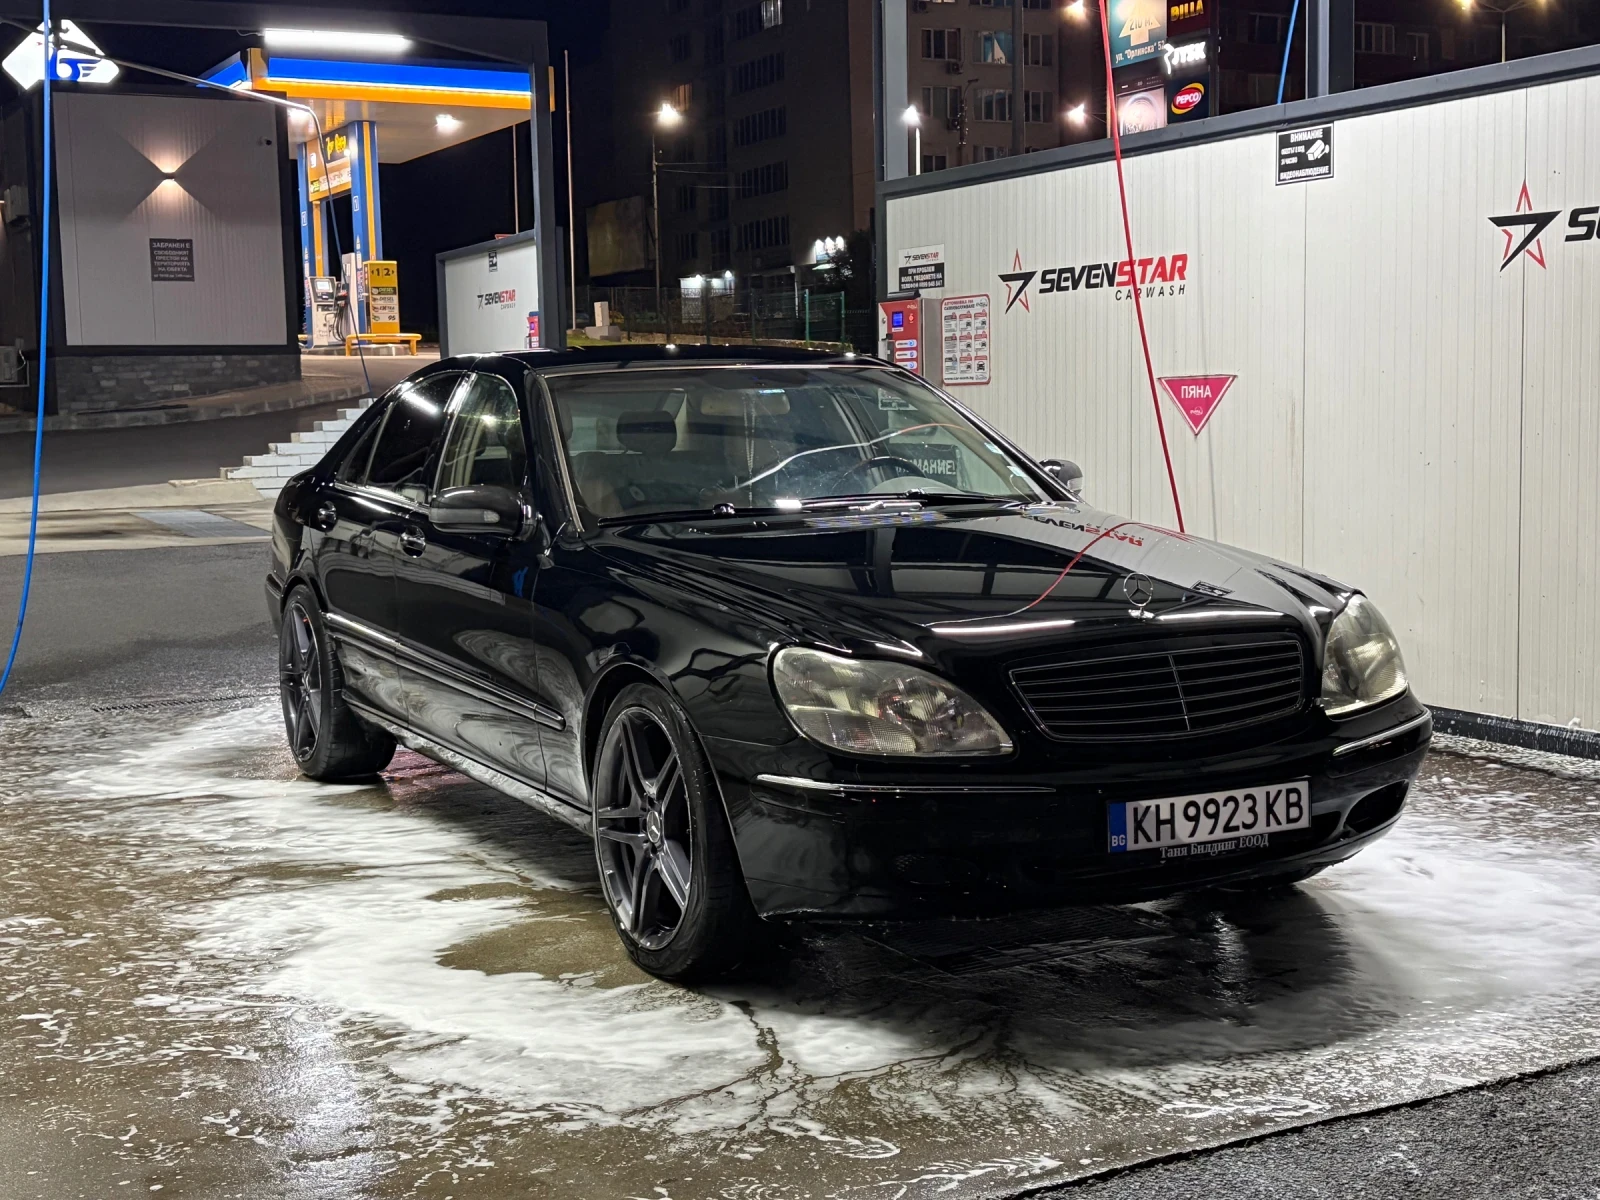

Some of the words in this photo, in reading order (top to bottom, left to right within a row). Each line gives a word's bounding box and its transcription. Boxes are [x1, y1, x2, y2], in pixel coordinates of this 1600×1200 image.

[1170, 0, 1204, 21] BILLA
[1176, 91, 1199, 105] PEPCO
[1290, 128, 1323, 143] ВНИМАНИЕ
[1564, 205, 1600, 242] S
[912, 251, 939, 261] SEVENSTAR
[375, 268, 380, 276] 1
[384, 268, 391, 276] 2
[1039, 254, 1188, 294] SEVENSTAR
[1181, 385, 1213, 399] ПЯНА
[1111, 834, 1126, 847] BG
[1160, 846, 1188, 859] Таня
[1190, 838, 1237, 857] Билдинг
[1239, 834, 1269, 849] ЕООД
